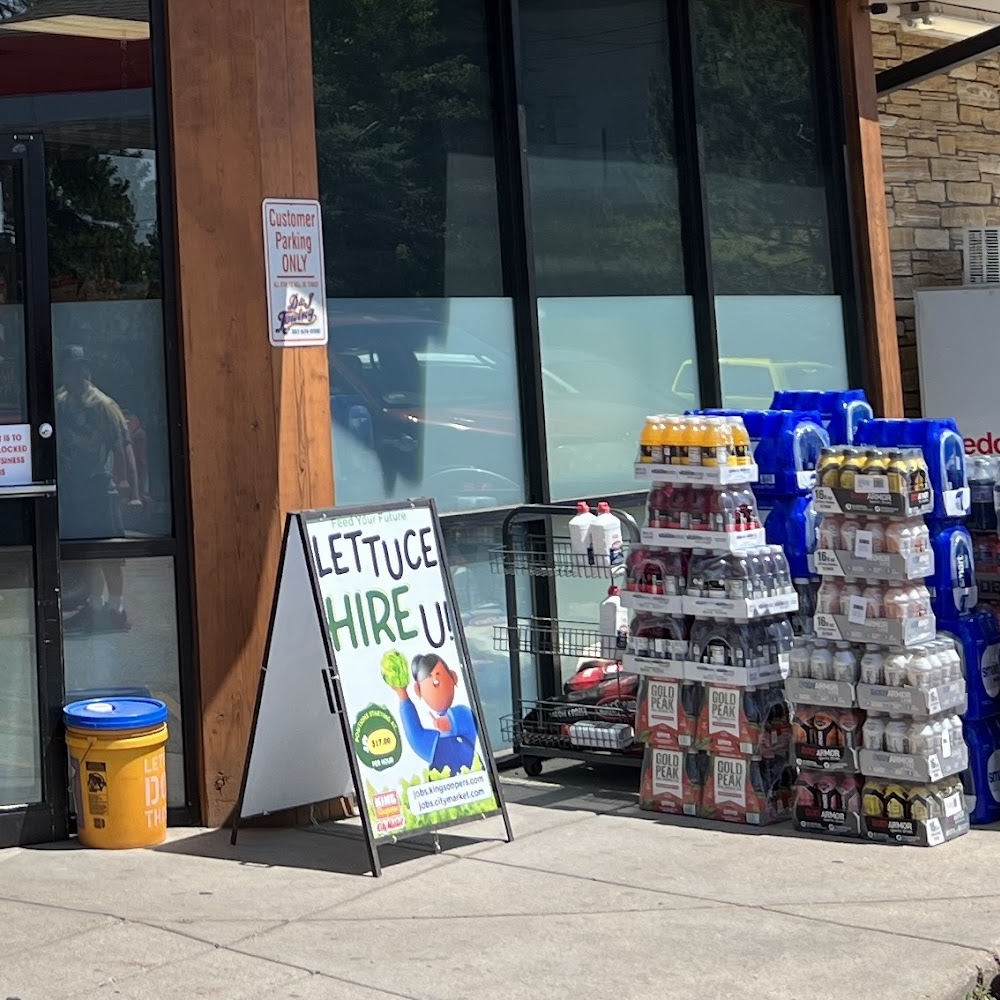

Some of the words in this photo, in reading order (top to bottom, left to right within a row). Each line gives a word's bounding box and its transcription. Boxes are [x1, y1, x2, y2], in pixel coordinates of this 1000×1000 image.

[269, 209, 315, 227] Customer
[275, 231, 312, 254] Parking
[282, 254, 307, 272] ONLY
[3, 433, 10, 441] IS
[12, 433, 22, 441] TO
[331, 516, 355, 529] Feed
[356, 515, 377, 527] Your
[378, 511, 408, 525] Future
[312, 526, 438, 580] LETTUCE
[325, 585, 419, 652] HIRE
[418, 600, 454, 648] U!
[651, 684, 675, 698] GOLD
[712, 690, 736, 705] GOLD
[651, 697, 674, 711] PEAK
[712, 704, 736, 718] PEAK
[371, 737, 391, 749] $17.00
[655, 753, 679, 767] GOLD
[717, 760, 743, 775] GOLD
[655, 765, 679, 780] PEAK
[412, 775, 485, 800] jobs.kingsoopers.com
[717, 773, 742, 788] PEAK
[418, 788, 485, 812] jobs.citymarket.com
